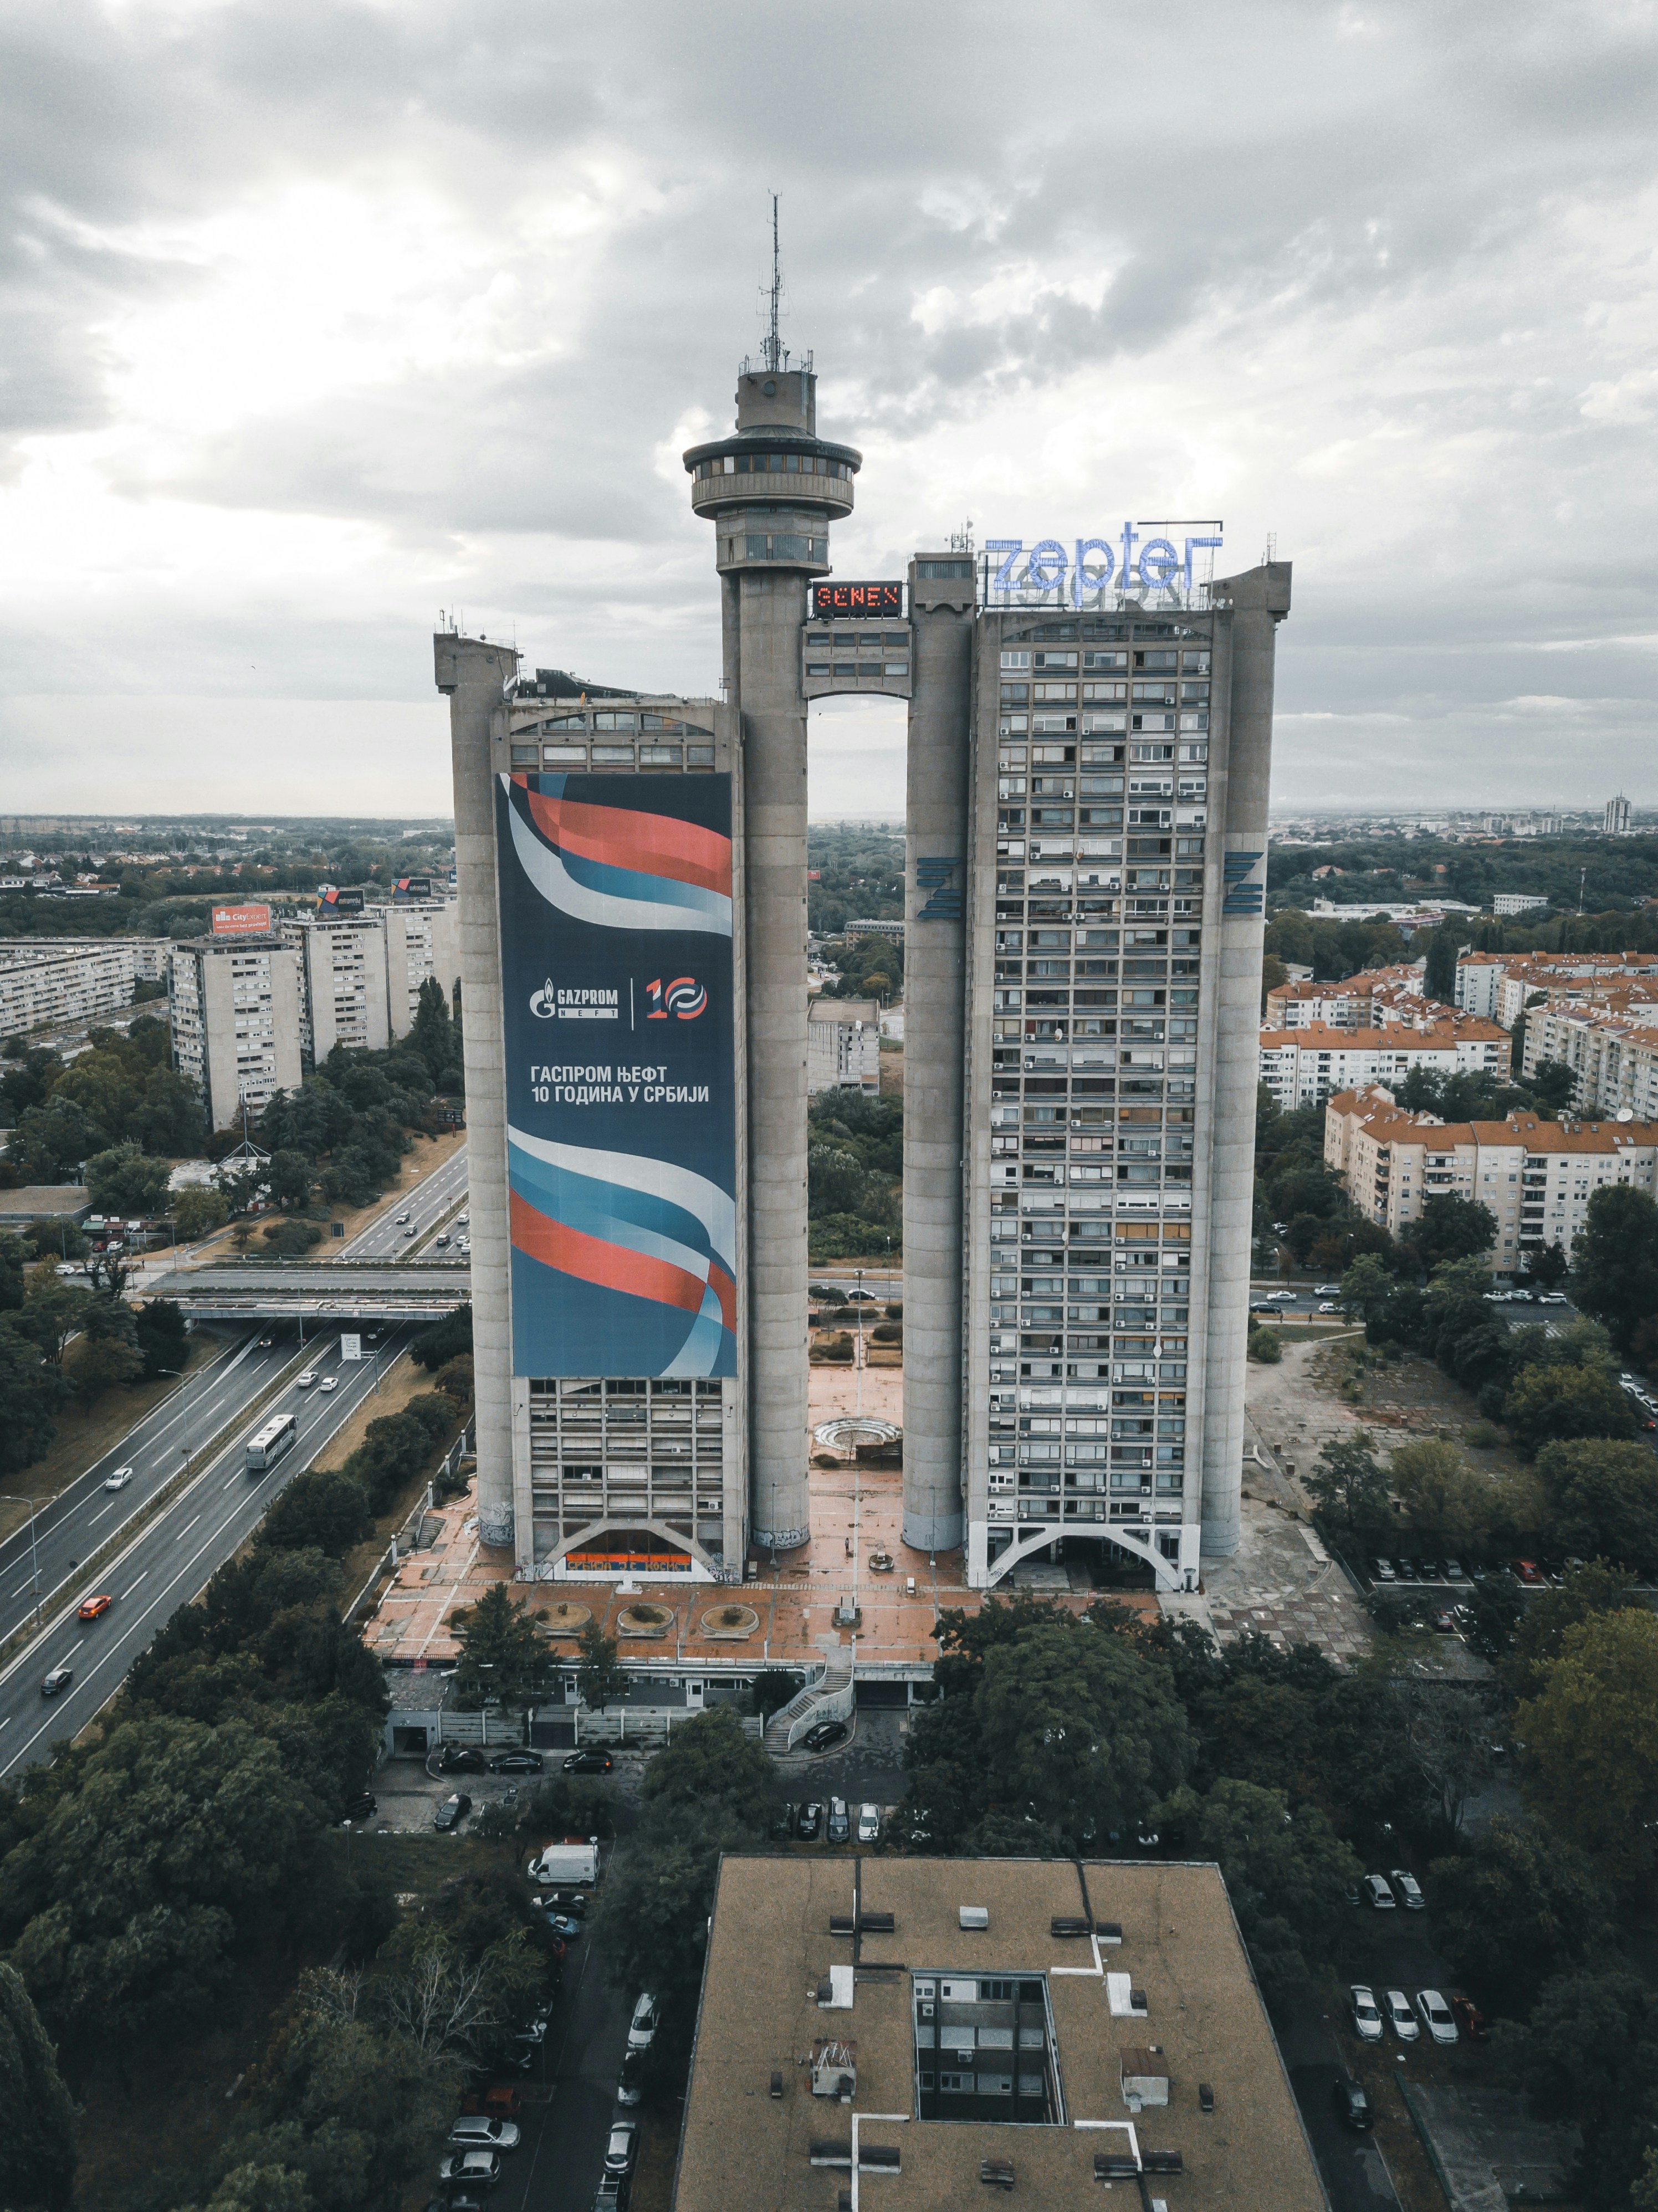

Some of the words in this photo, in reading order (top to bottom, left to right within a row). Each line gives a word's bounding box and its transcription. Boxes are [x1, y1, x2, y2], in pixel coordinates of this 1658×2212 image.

[985, 521, 1222, 607] zepter
[233, 913, 266, 921] CityExpert
[557, 989, 618, 1005] GAZPROM
[646, 977, 707, 1020] 10
[531, 1066, 611, 1083] ГАСПРОМ
[617, 1066, 667, 1083] ЊЕФТ
[531, 1086, 549, 1103] 10
[555, 1086, 623, 1105] ГОДИНА
[628, 1086, 639, 1103] У
[644, 1086, 709, 1103] СРБИЈИ
